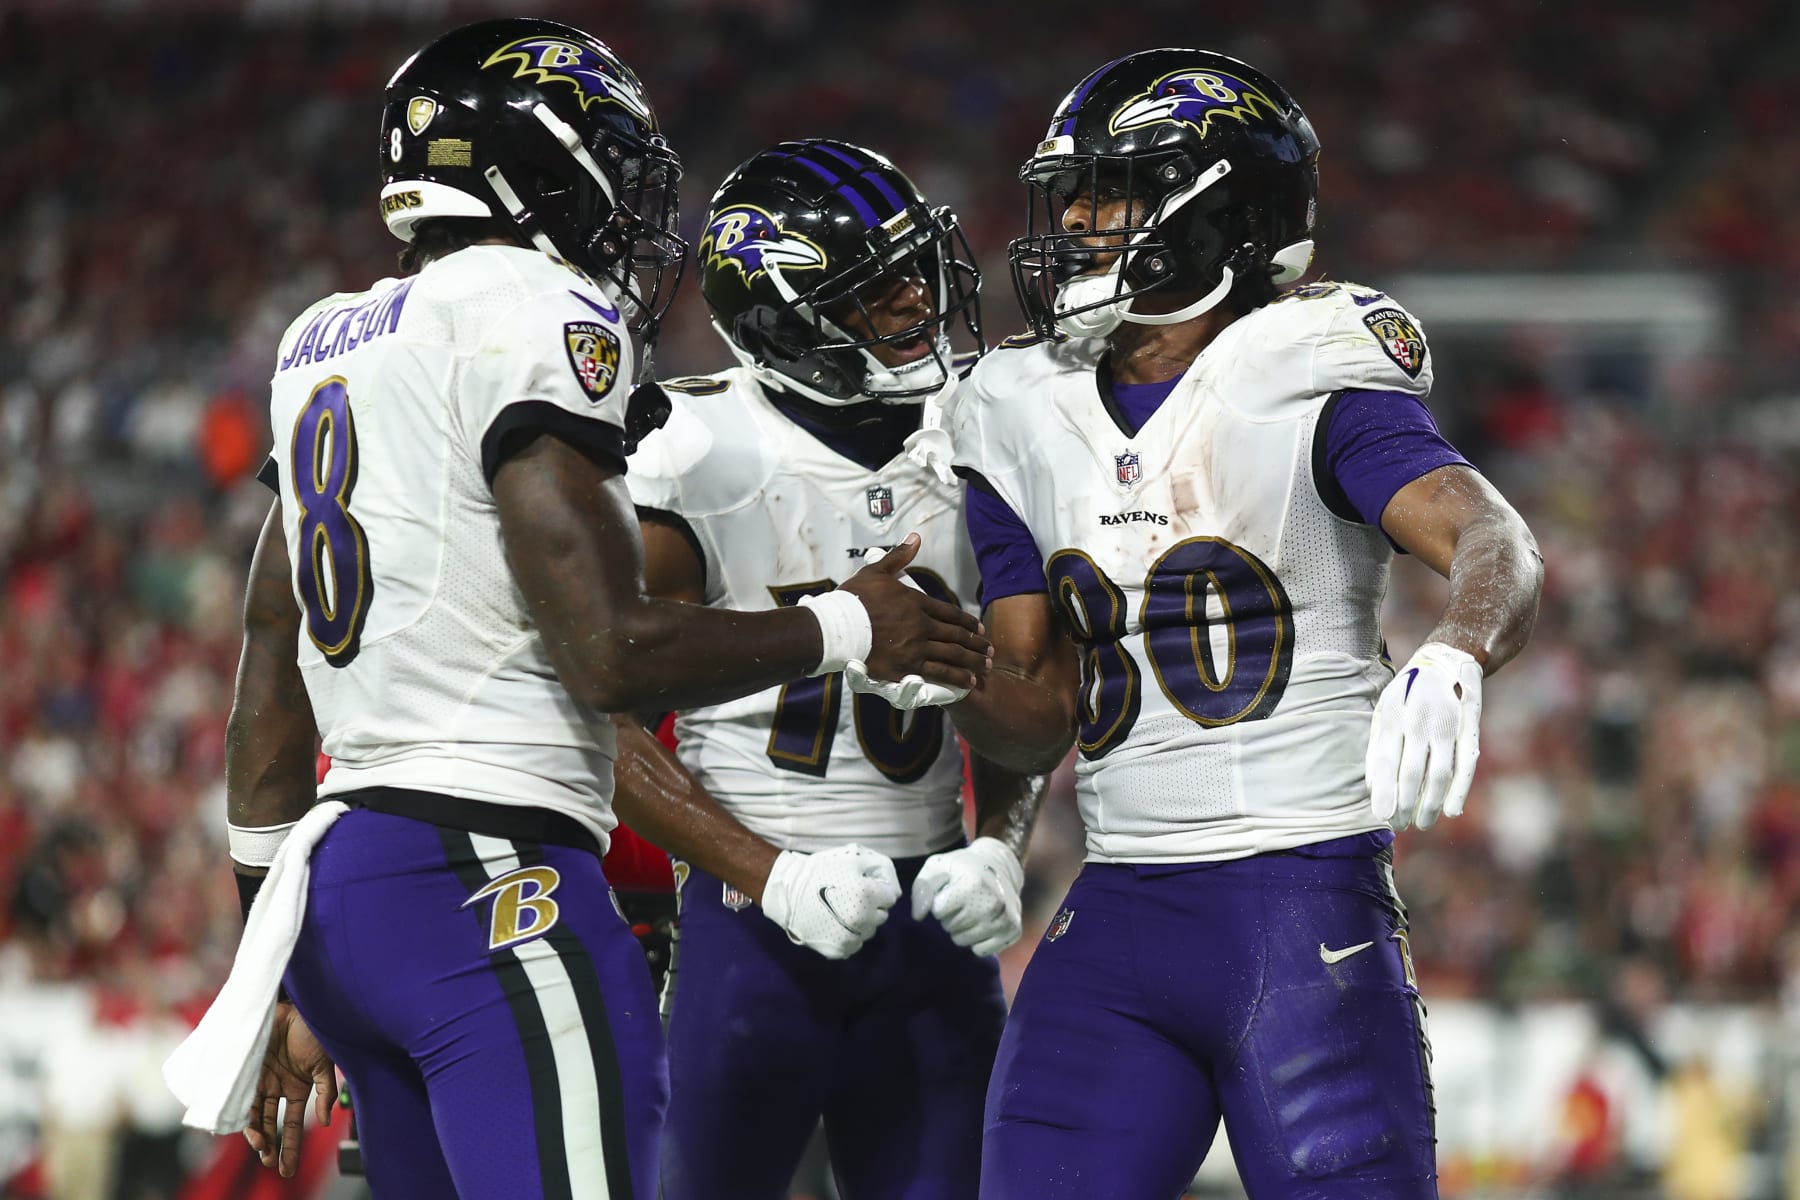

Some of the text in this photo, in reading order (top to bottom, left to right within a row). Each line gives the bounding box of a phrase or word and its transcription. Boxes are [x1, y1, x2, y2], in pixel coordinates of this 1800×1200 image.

[521, 41, 583, 68] B
[1168, 73, 1238, 102] B
[391, 127, 402, 162] 8
[711, 212, 750, 252] B
[1366, 310, 1406, 324] RAVENS
[567, 324, 617, 345] RAVENS
[1118, 465, 1138, 481] NFL
[290, 375, 374, 668] 8
[1099, 510, 1168, 526] RAVENS
[1046, 535, 1295, 761] 80
[461, 865, 561, 950] B
